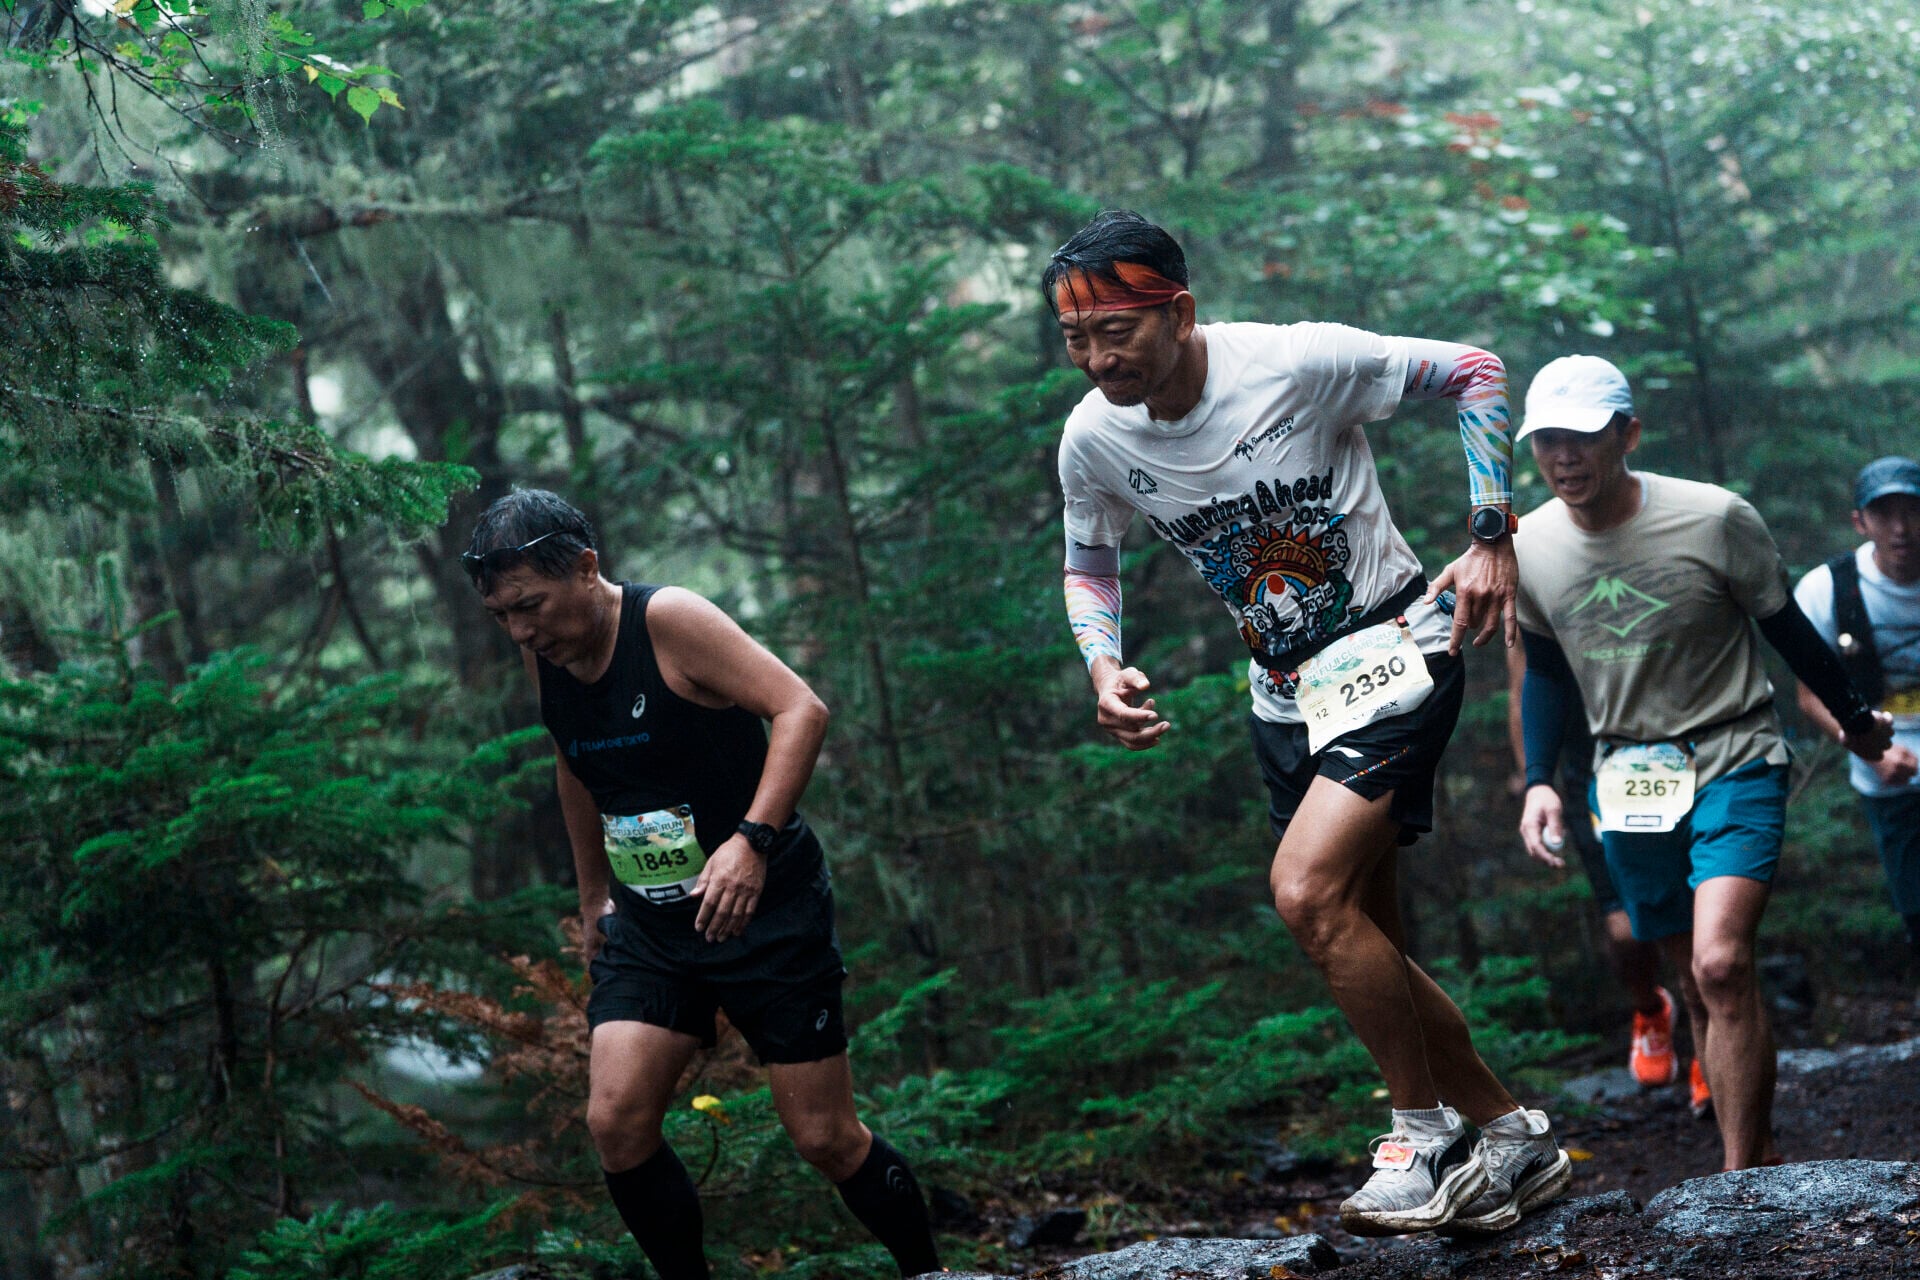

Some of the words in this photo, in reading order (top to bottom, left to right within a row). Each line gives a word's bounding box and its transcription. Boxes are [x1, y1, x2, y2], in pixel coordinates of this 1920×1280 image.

[1256, 467, 1333, 516] Ahead
[1341, 639, 1374, 660] CLIMB
[1340, 655, 1406, 708] 2330
[1315, 708, 1329, 721] 12
[1625, 779, 1681, 797] 2367
[661, 820, 684, 832] RUN
[632, 847, 689, 872] 1843
